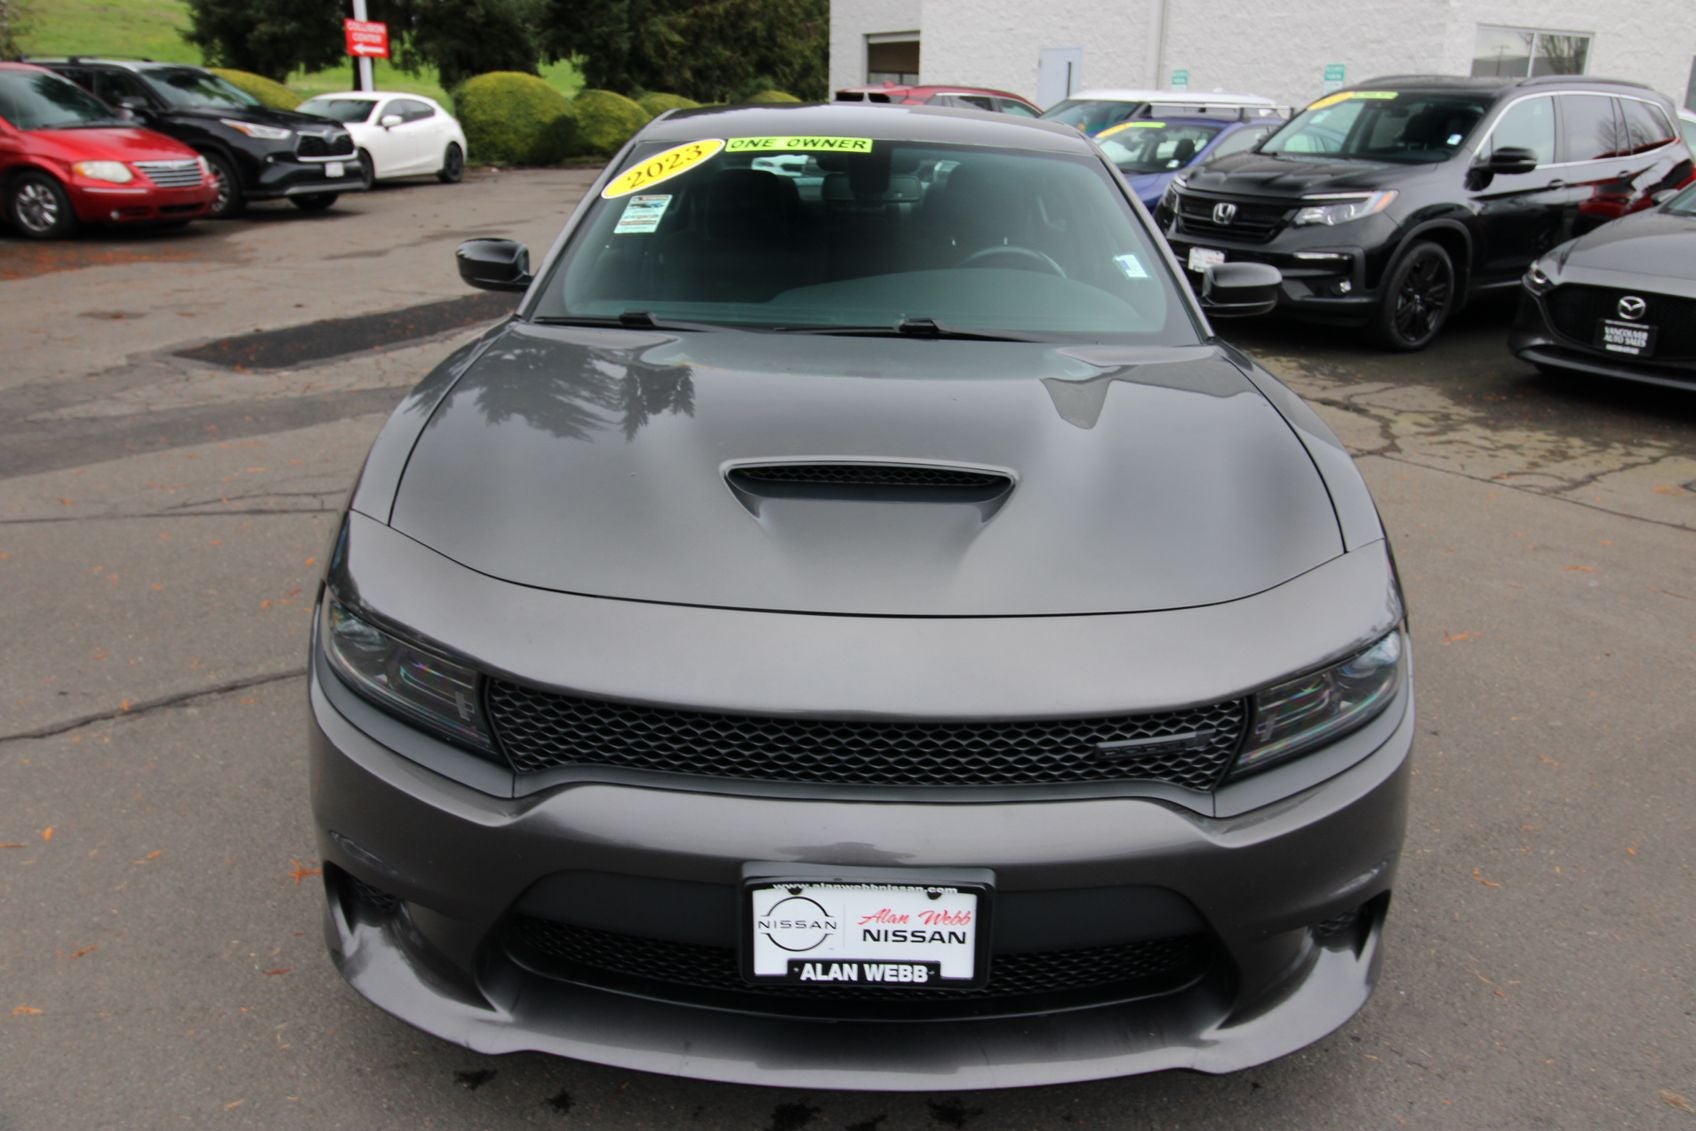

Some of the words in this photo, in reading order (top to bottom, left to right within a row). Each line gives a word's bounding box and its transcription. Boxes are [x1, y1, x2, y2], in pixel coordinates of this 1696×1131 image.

[730, 138, 778, 149] ONE
[786, 138, 868, 150] OWNER
[626, 144, 704, 190] 2023
[758, 920, 837, 930] NISSAN
[858, 908, 910, 926] Alan
[918, 909, 972, 926] Webb
[862, 928, 967, 945] NISSAN
[800, 963, 859, 982] ALAN
[862, 964, 930, 983] WEBB
